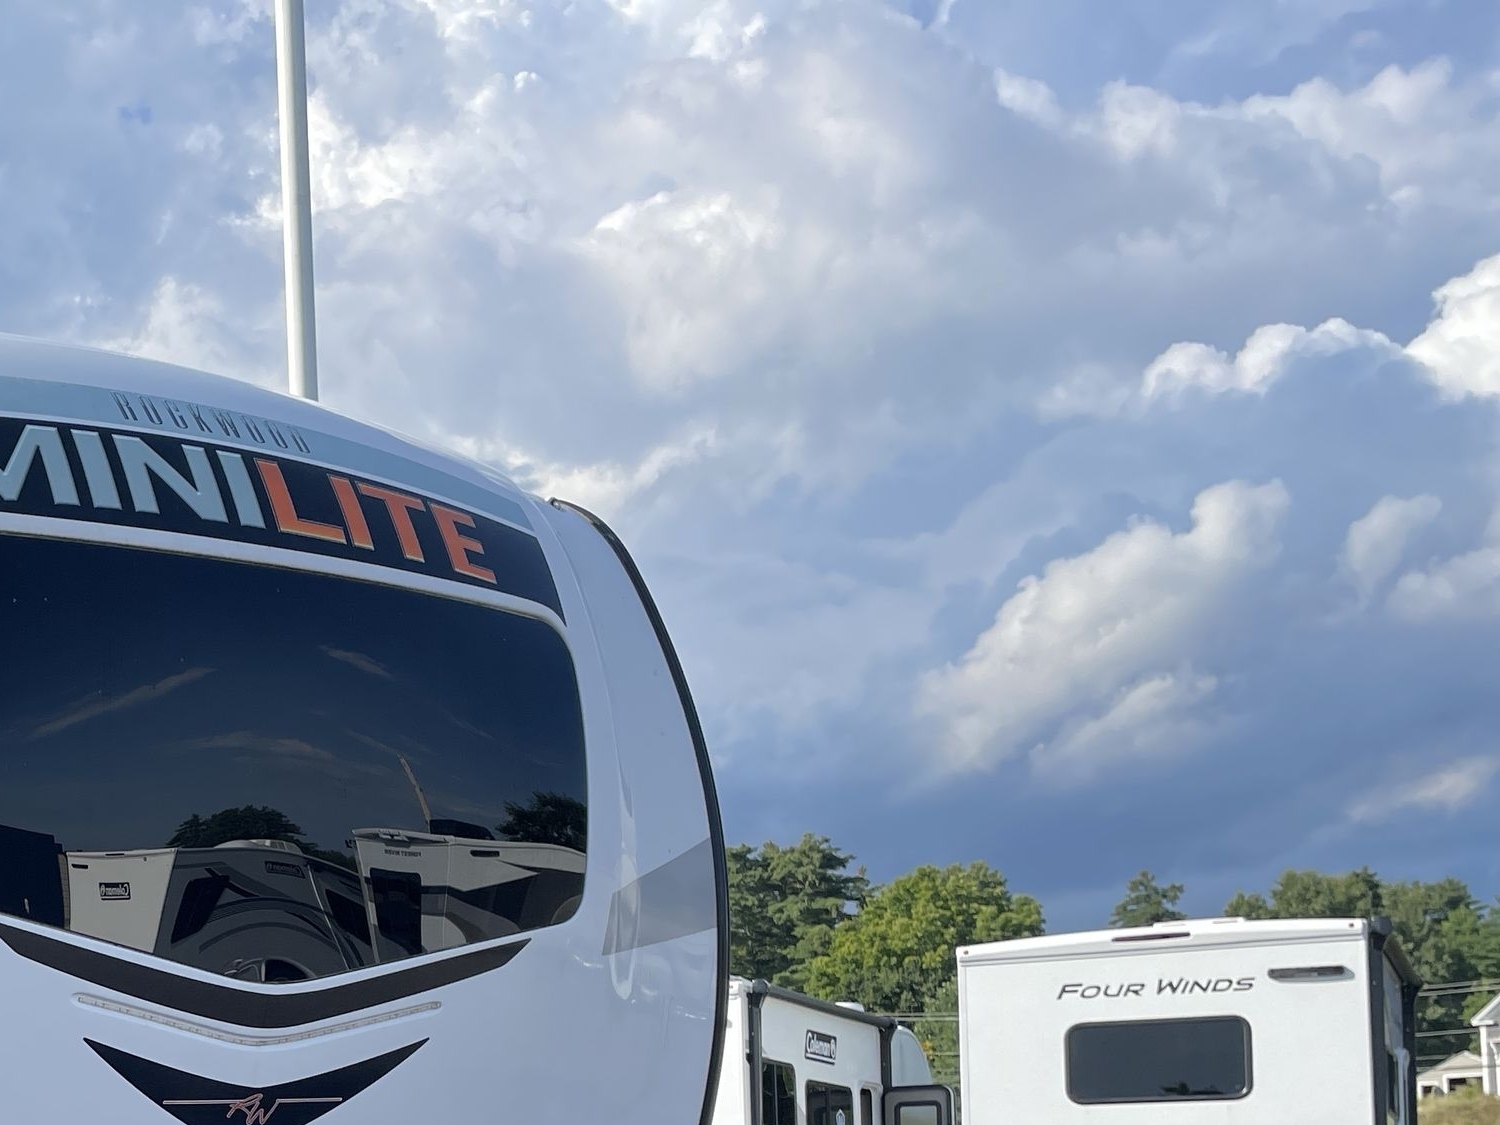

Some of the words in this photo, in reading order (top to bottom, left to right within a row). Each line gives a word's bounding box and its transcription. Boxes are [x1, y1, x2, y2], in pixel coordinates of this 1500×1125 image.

[110, 391, 311, 454] ROCKWOOD
[1057, 983, 1145, 1000] FOUR
[1156, 977, 1256, 996] WINDS
[806, 1031, 830, 1057] Coleman
